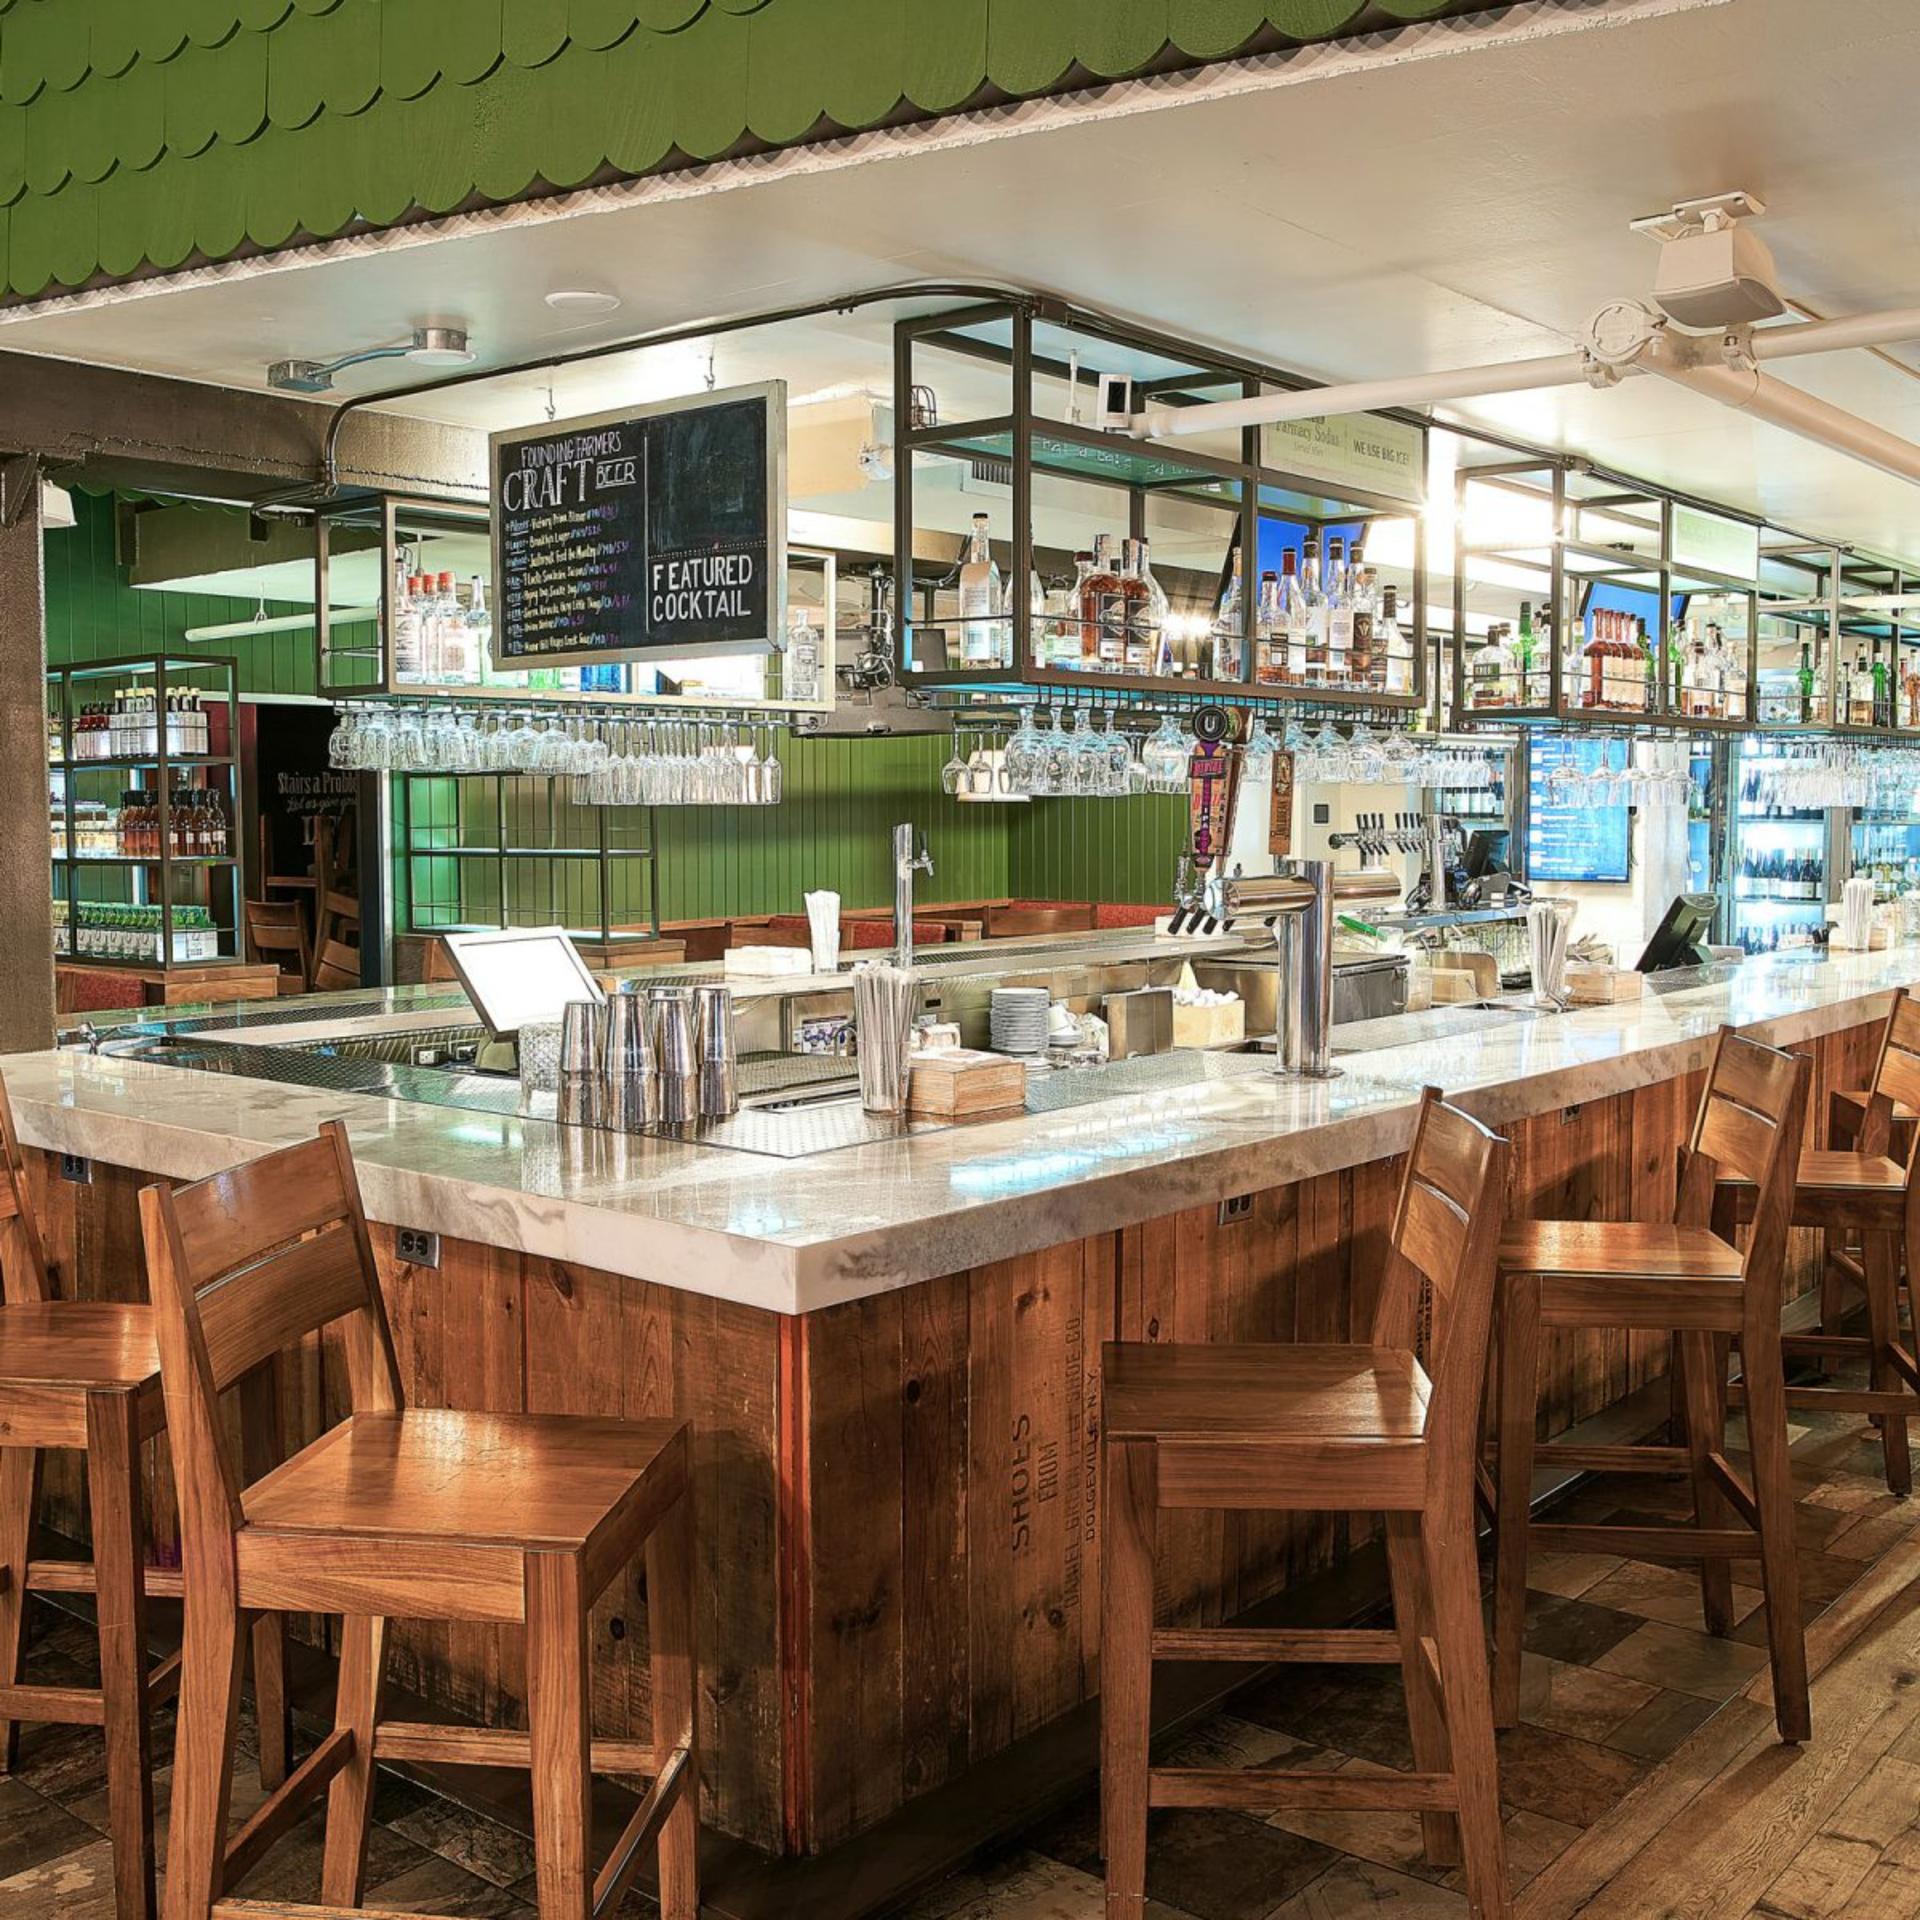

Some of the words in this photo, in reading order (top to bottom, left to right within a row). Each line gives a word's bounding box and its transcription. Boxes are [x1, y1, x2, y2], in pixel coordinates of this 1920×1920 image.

[521, 438, 576, 468] FOUNDING
[576, 430, 622, 459] FARMERS
[503, 458, 595, 511] CRAFT
[595, 462, 636, 487] BEER
[653, 554, 753, 592] FEATURED
[653, 589, 752, 622] COCKTAIL
[1204, 715, 1217, 732] U
[278, 771, 312, 795] Stairs
[312, 776, 320, 794] a
[1012, 1414, 1030, 1552] SHOES
[1038, 1440, 1058, 1504] FROM
